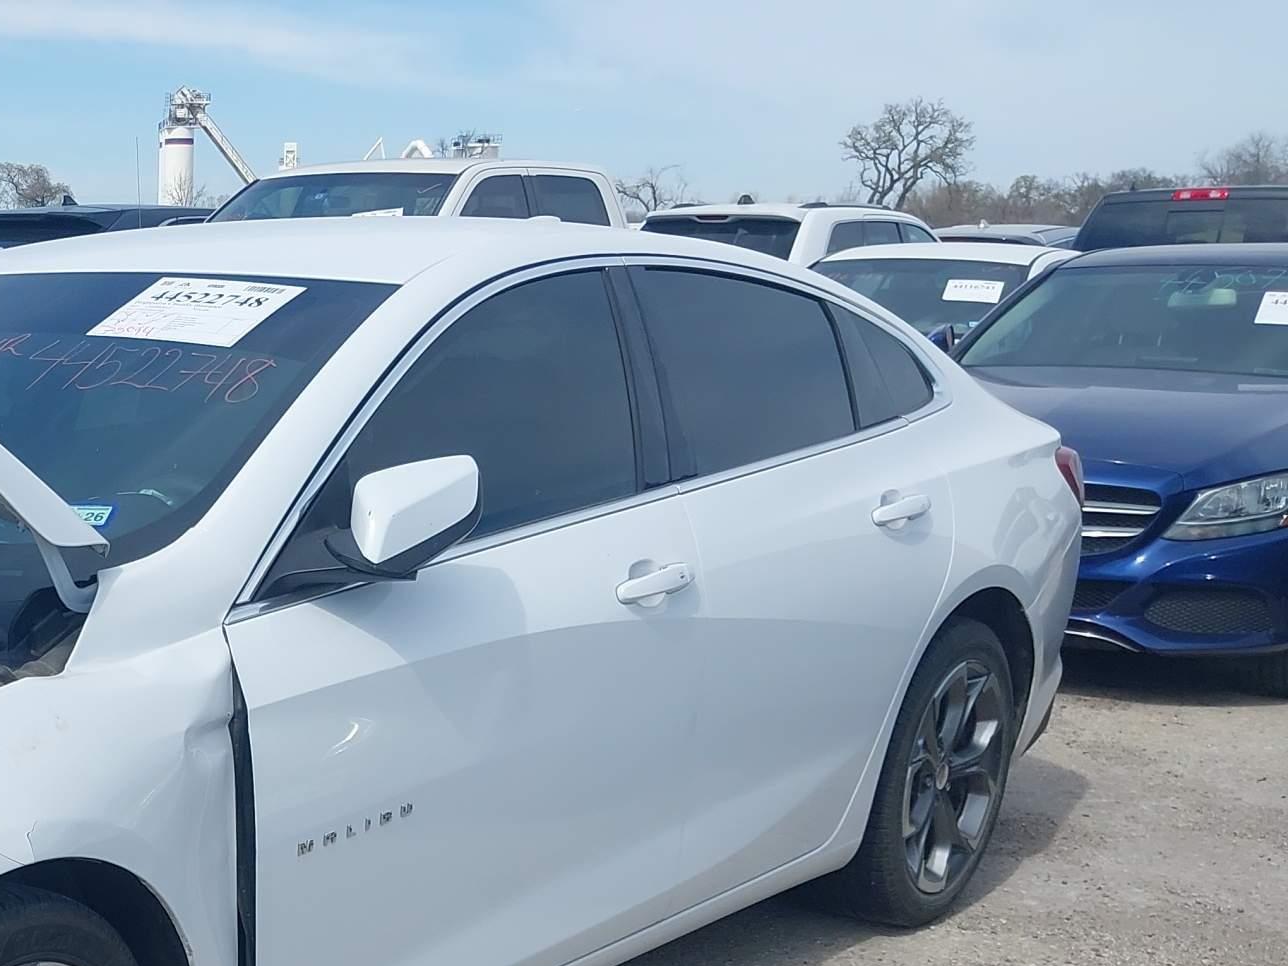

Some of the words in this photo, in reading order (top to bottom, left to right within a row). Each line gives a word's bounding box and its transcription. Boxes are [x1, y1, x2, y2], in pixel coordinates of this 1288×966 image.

[150, 291, 270, 309] 44522748
[25, 338, 277, 404] 44522748
[297, 802, 414, 857] MALIBU
